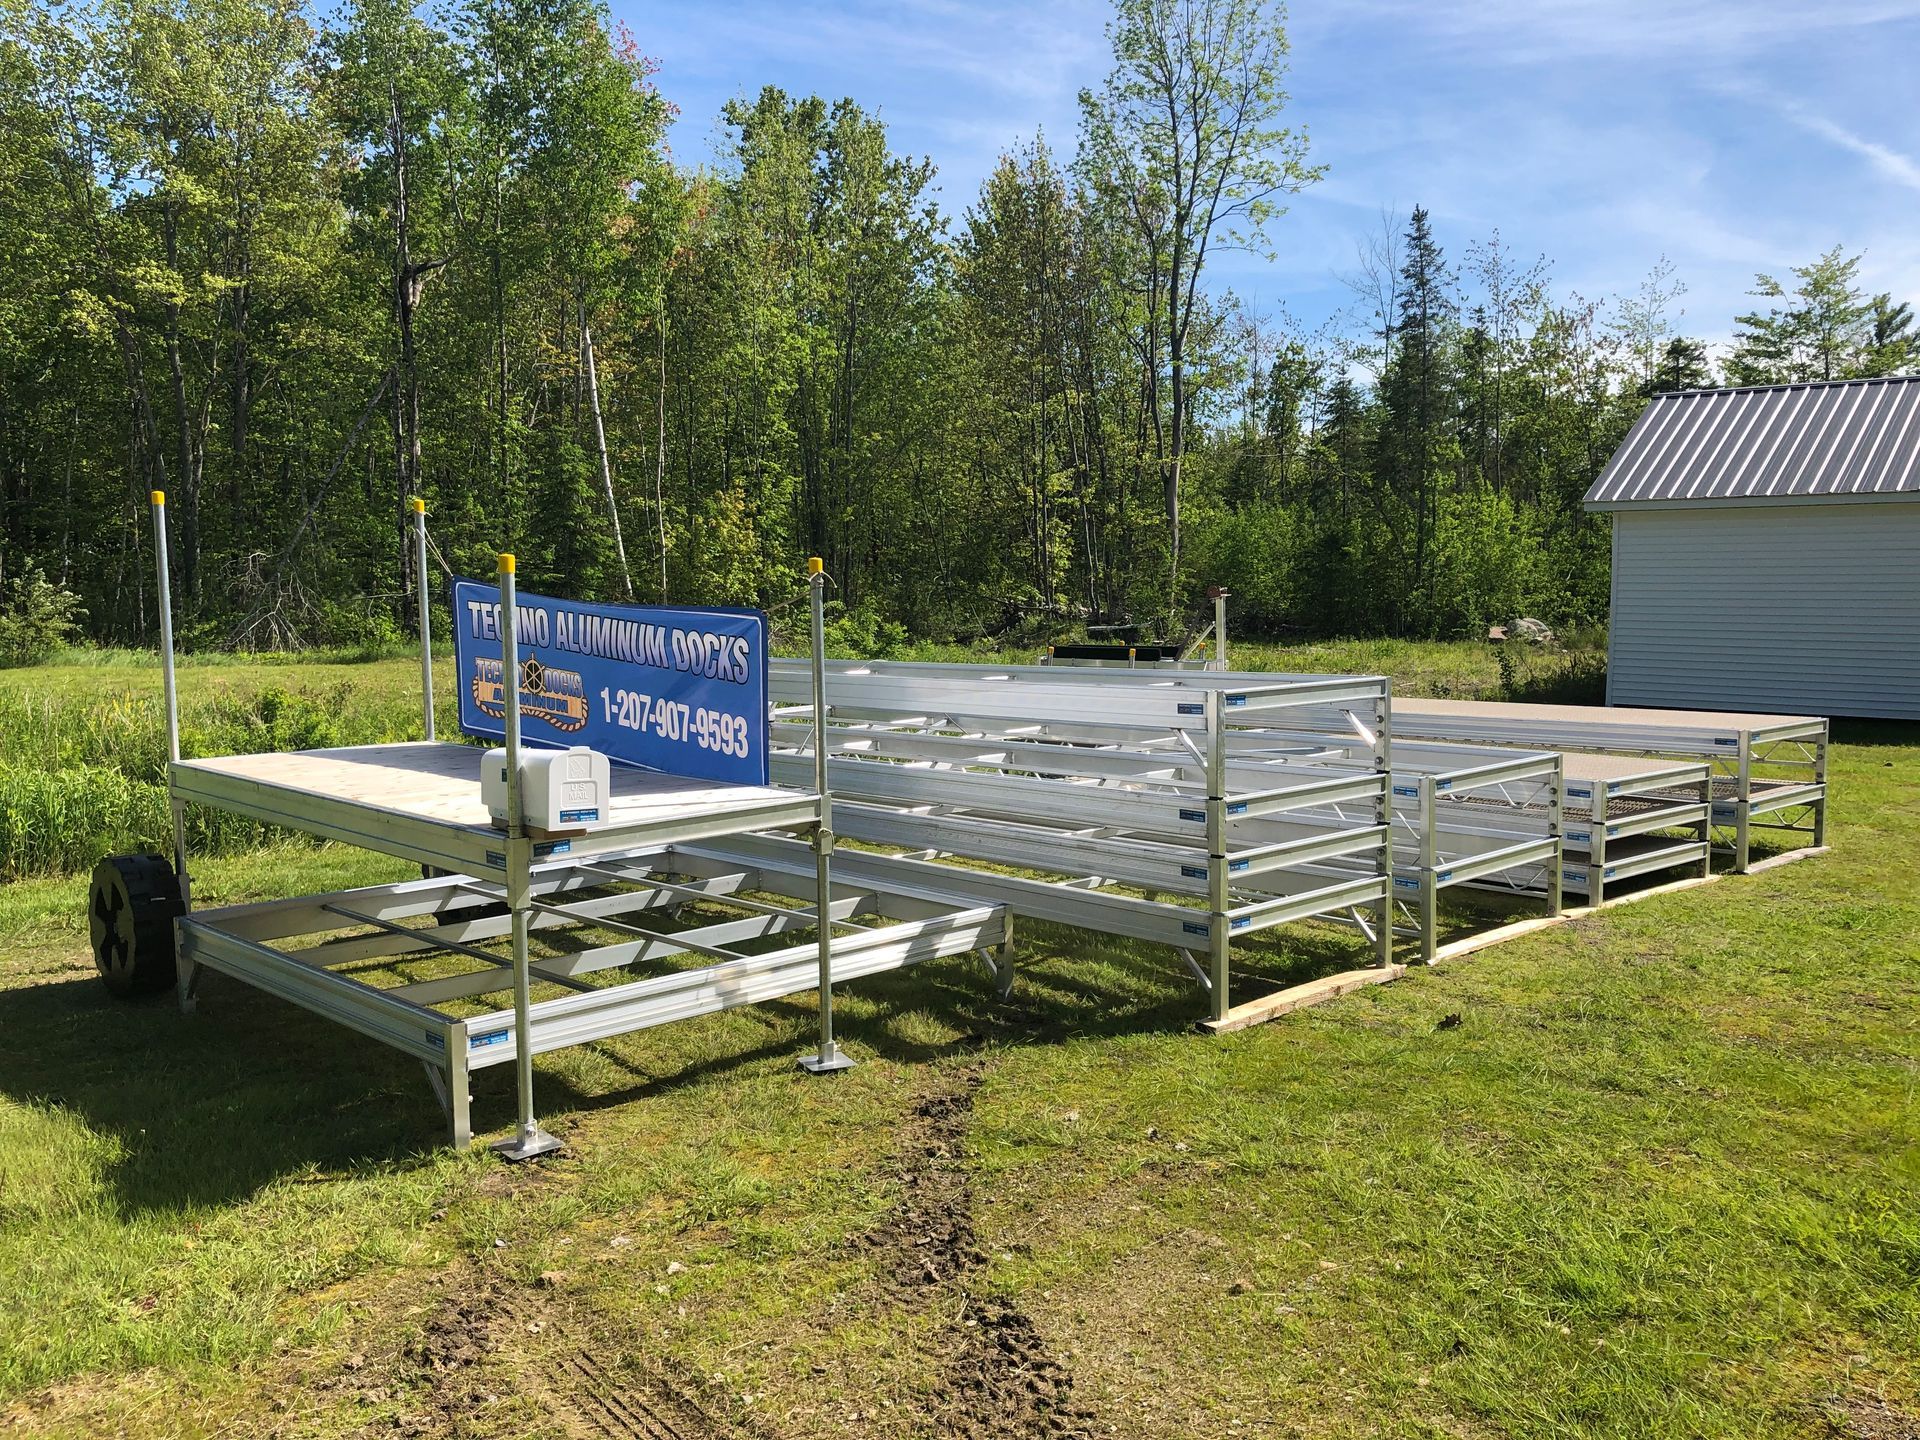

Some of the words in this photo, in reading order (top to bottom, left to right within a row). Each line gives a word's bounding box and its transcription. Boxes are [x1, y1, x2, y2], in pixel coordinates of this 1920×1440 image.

[556, 611, 669, 668] ALUMINUM
[672, 628, 750, 685] DOCKS
[543, 669, 583, 697] DOCKS
[492, 687, 568, 714] AMINUM
[600, 686, 749, 759] 1-207-907-9593
[568, 791, 589, 800] MAIL
